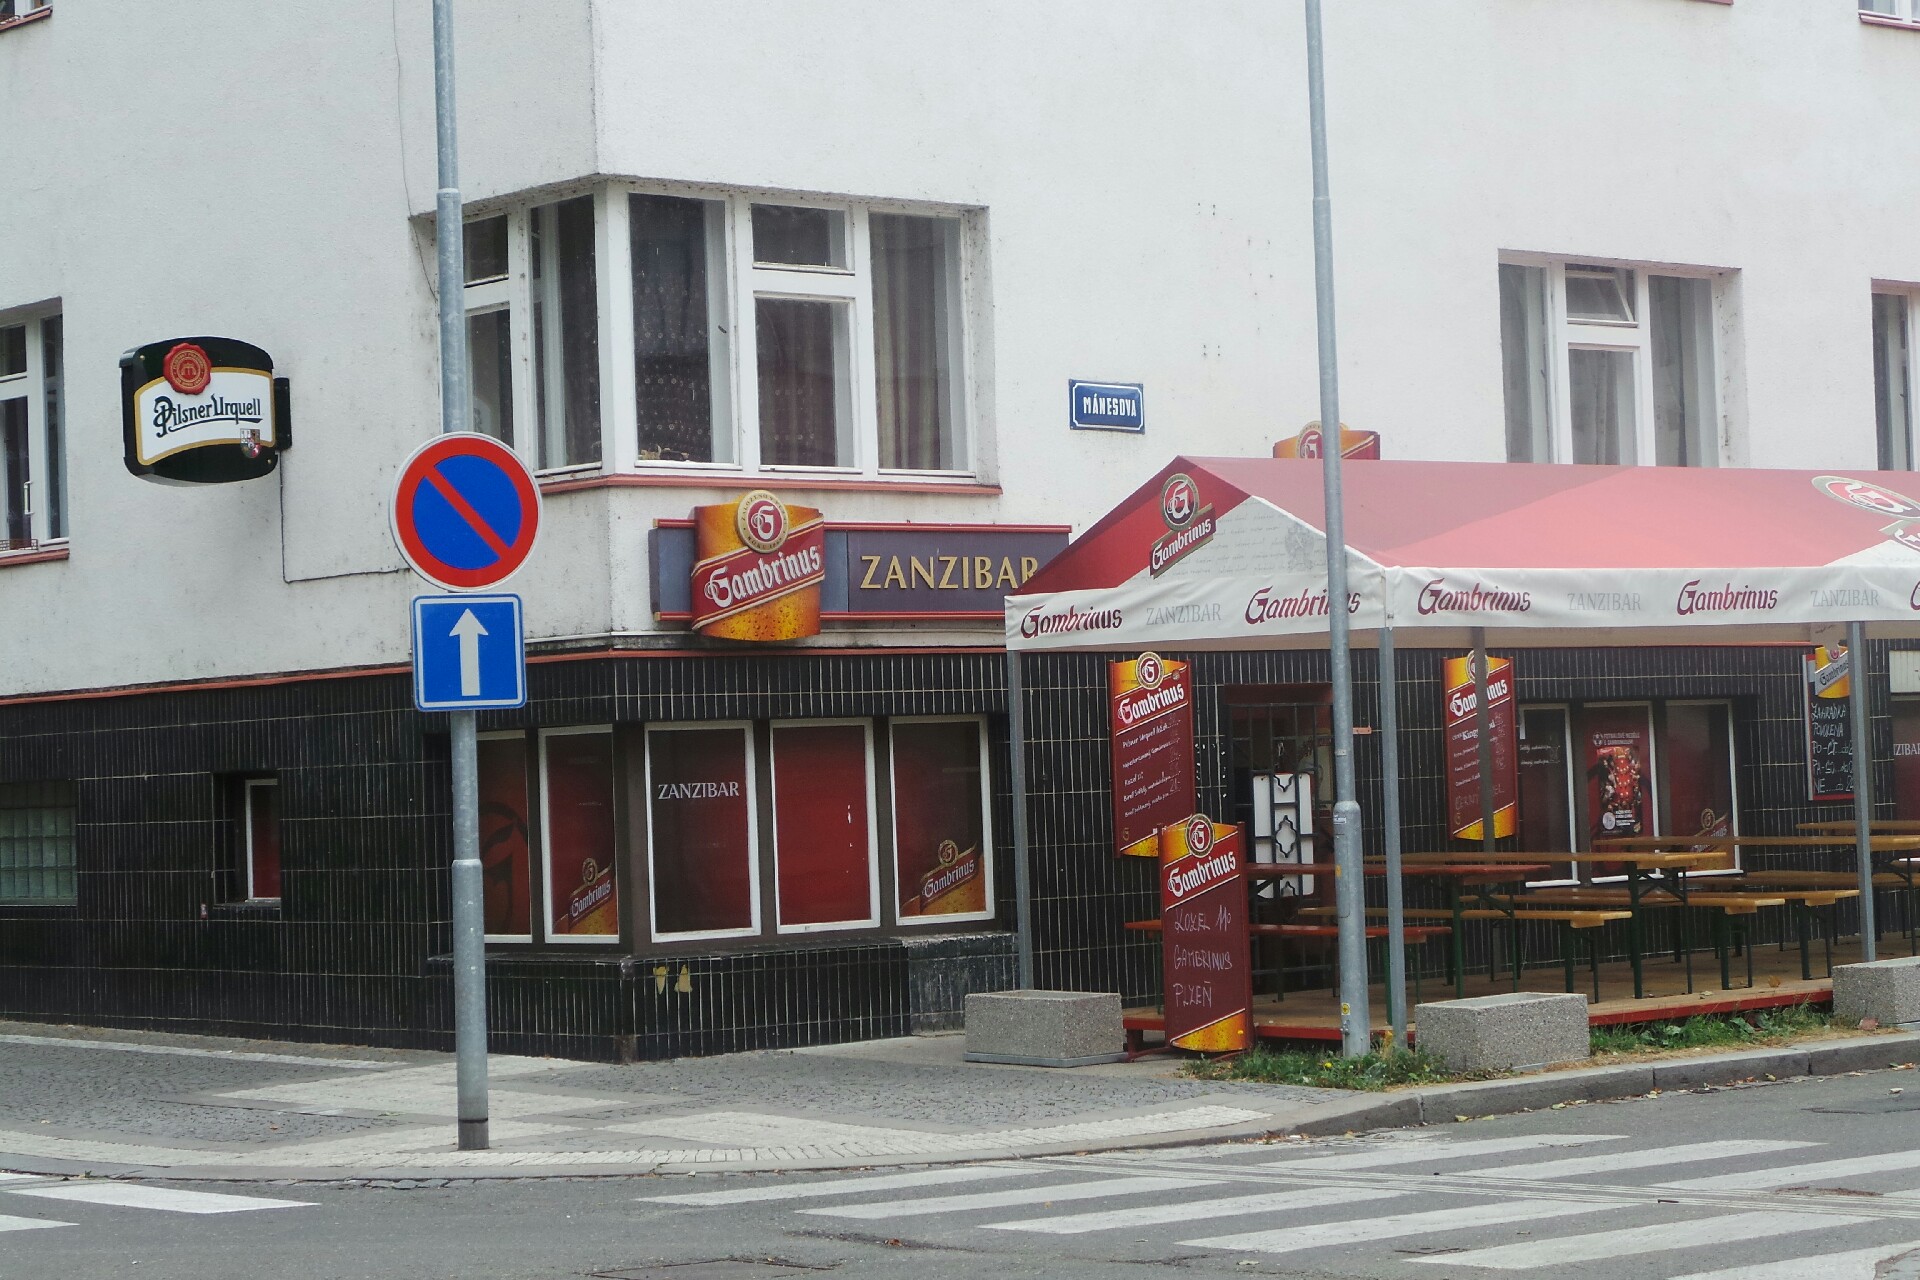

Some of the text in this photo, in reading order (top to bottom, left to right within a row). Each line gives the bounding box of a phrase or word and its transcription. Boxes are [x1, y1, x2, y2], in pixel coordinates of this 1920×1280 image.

[153, 394, 261, 438] Pilsner Urquell
[1083, 393, 1136, 417] MÁNESOVA
[1152, 518, 1212, 570] Gambrinus
[704, 546, 820, 608] Gambrinus
[860, 555, 1038, 589] ZANZIBAR
[1417, 577, 1531, 616] Gambrinus
[1567, 592, 1641, 611] ZANZIBAR
[1676, 579, 1778, 616] Gambrinus
[1810, 589, 1880, 607] ZANZIBAR
[1020, 604, 1123, 639] Gambrinus
[1146, 603, 1222, 626] ZANZIBAR
[1117, 684, 1185, 724] Gambrinus
[1450, 680, 1508, 717] Gaminus
[658, 781, 740, 800] ZANZIBAR
[922, 860, 975, 898] Gambrinus
[1168, 851, 1236, 898] Gambrinus
[570, 880, 612, 918] Gambrinus
[1173, 945, 1233, 971] GAMBRINUS
[1172, 980, 1212, 1008] PLZEŇ
